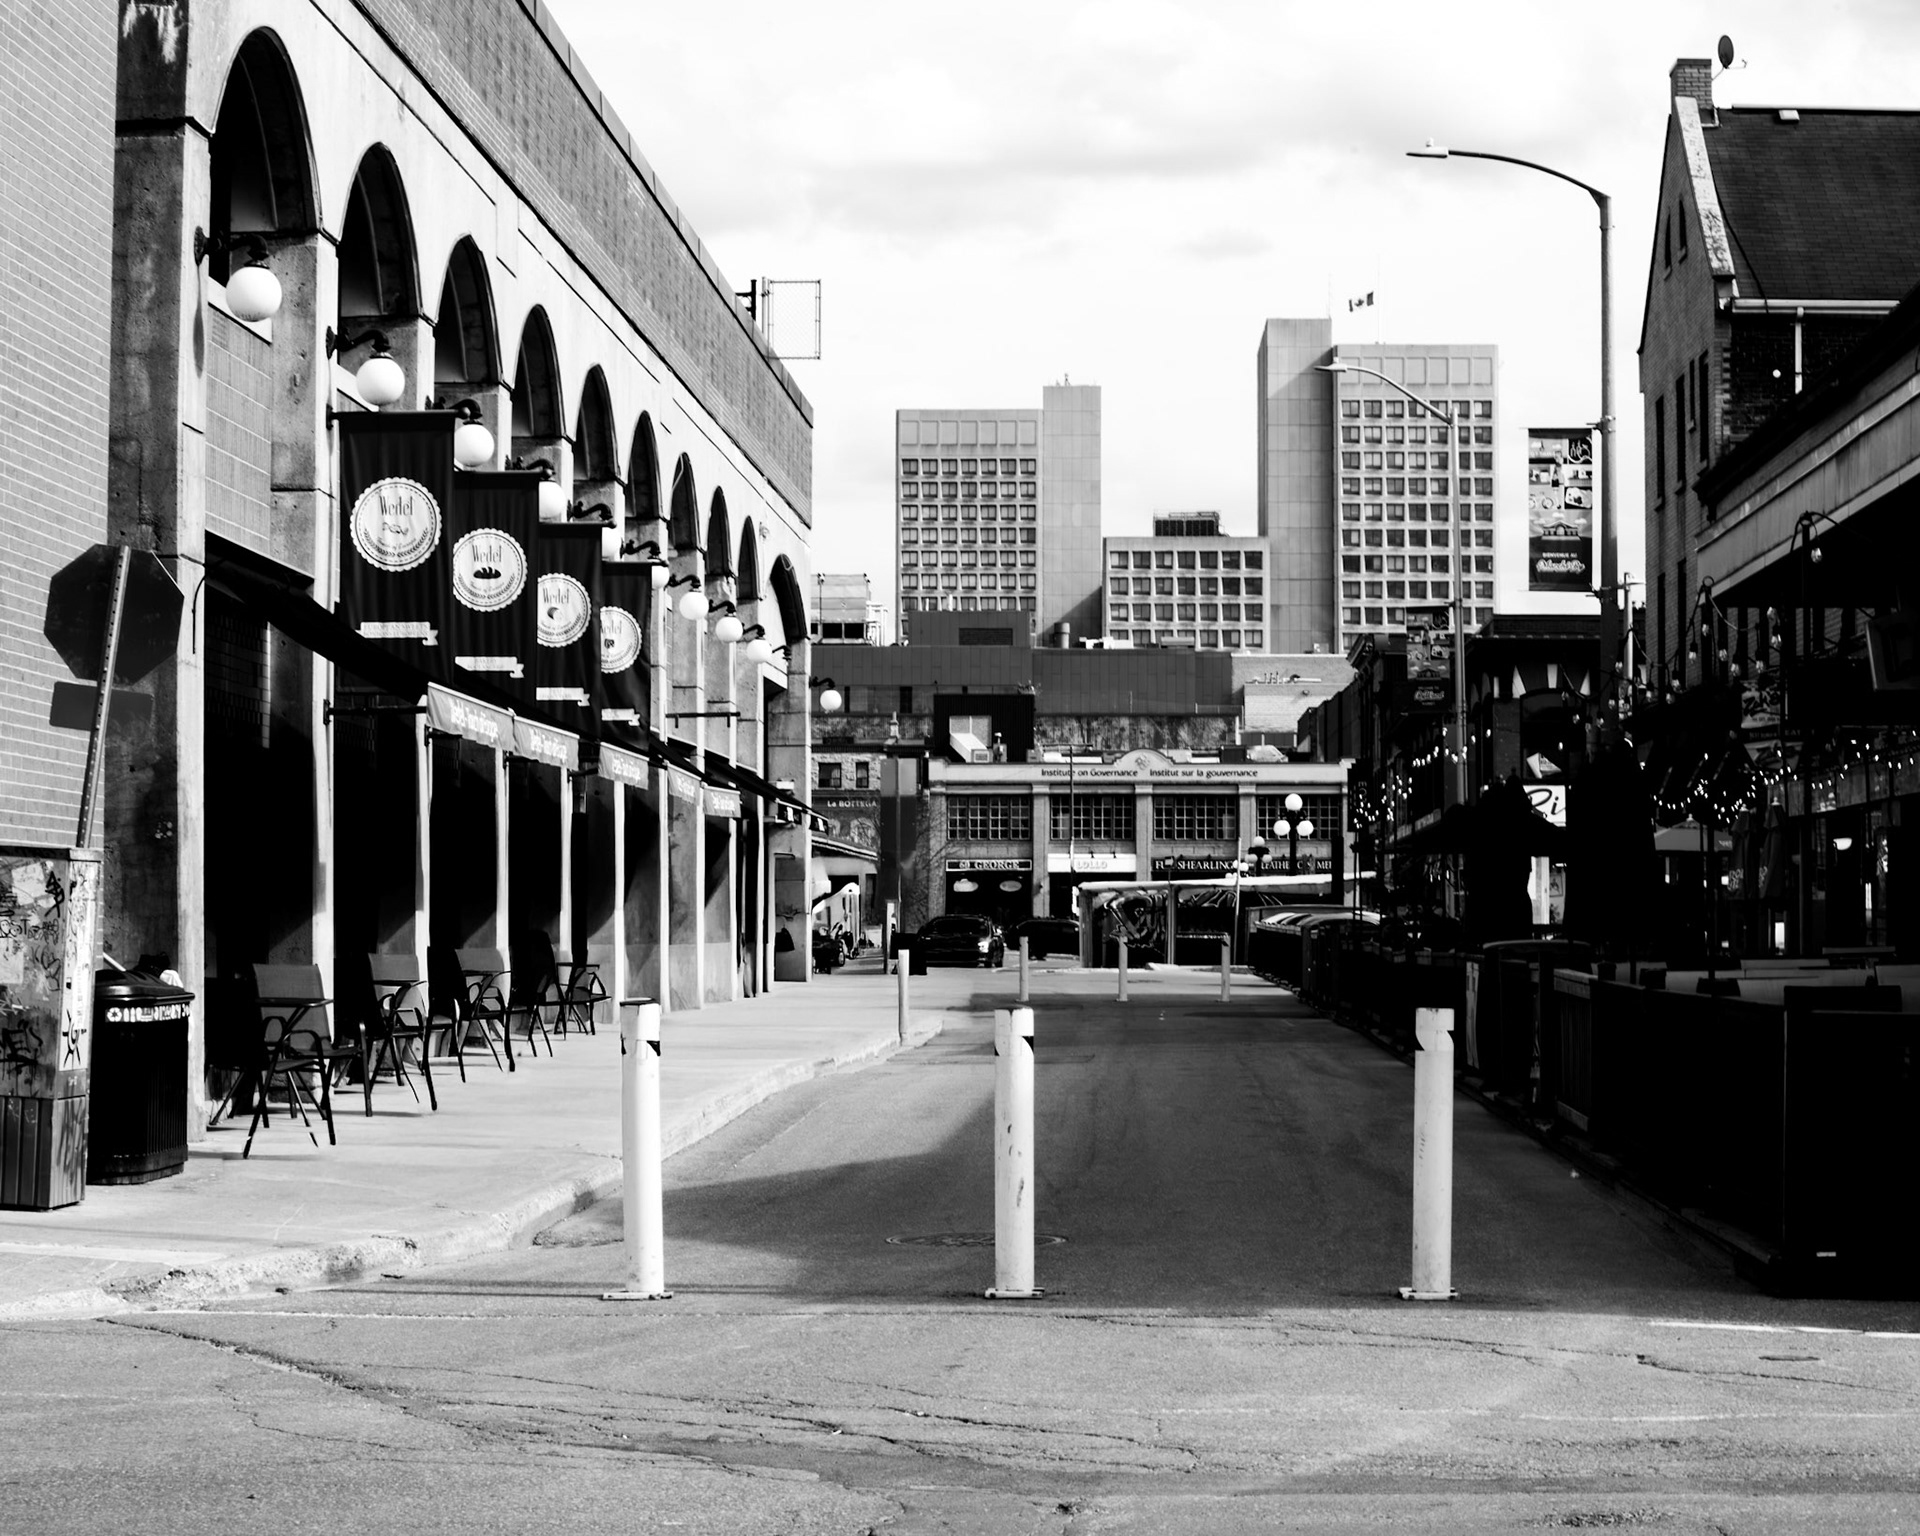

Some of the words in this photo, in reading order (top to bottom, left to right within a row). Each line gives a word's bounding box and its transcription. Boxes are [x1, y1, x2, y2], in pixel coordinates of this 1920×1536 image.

[379, 496, 414, 516] Wedel
[471, 545, 502, 563] Wedel
[542, 587, 570, 604] Wedel
[600, 620, 622, 635] edel
[1041, 768, 1076, 777] Institute
[1077, 769, 1089, 777] on
[1089, 768, 1139, 777] Governance
[1149, 768, 1179, 777] Institut
[1181, 769, 1194, 777] sur
[1196, 768, 1204, 777] la
[1205, 769, 1259, 779] gouvernance
[974, 861, 1020, 870] GEORGE
[1260, 860, 1291, 870] LEATHE
